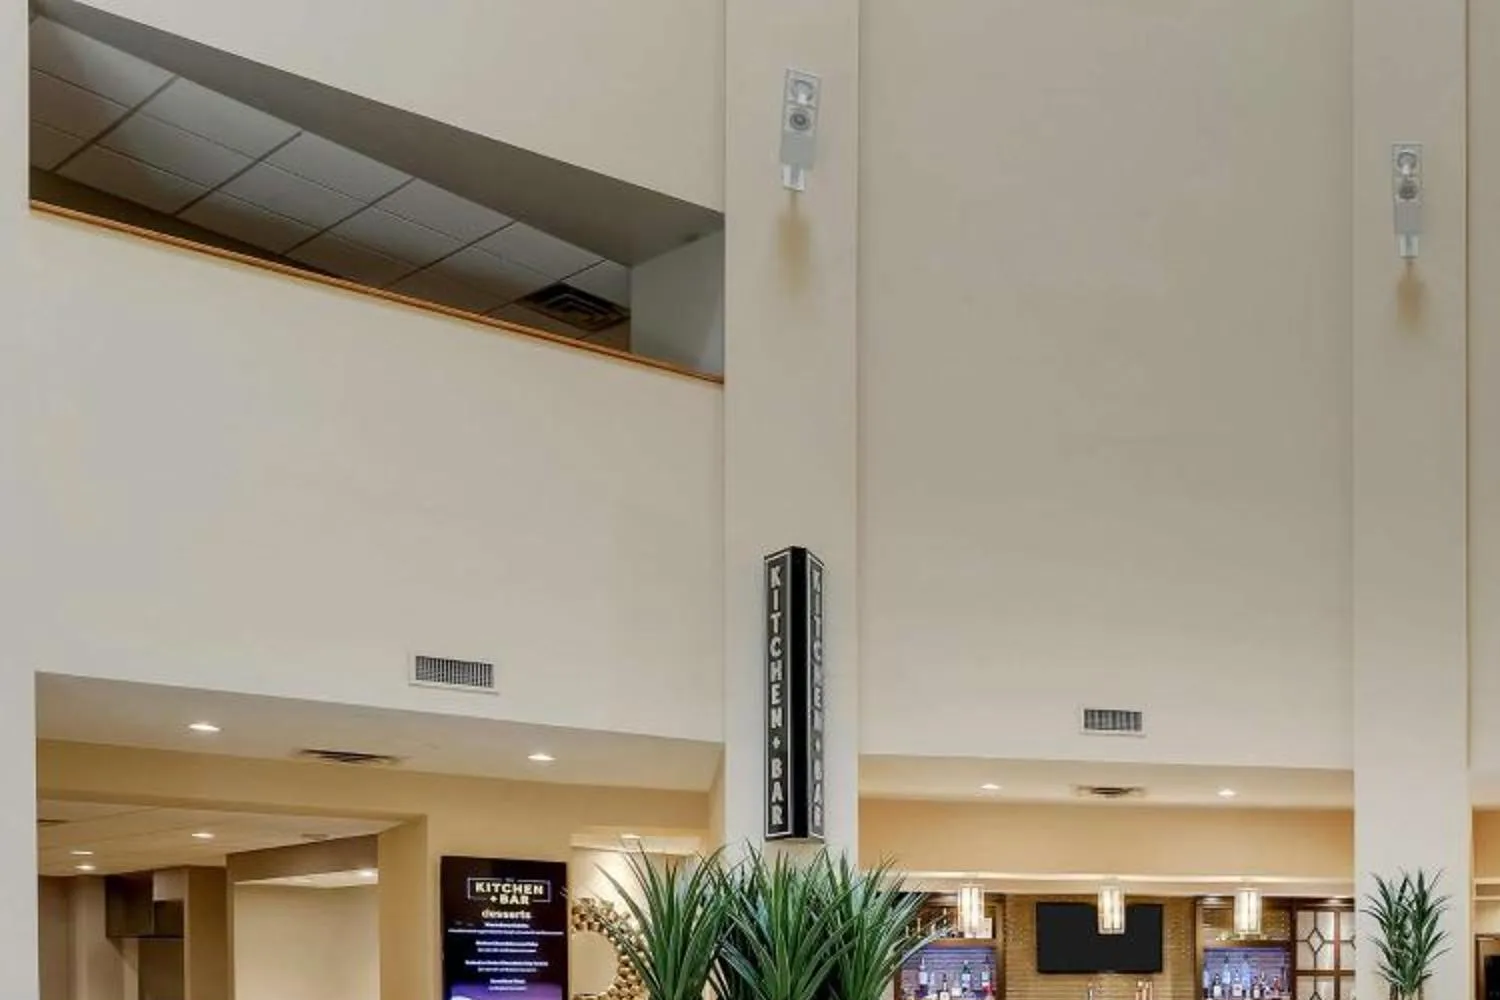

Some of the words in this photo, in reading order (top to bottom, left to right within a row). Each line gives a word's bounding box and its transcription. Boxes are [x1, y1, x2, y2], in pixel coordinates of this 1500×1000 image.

[770, 565, 783, 729] KITCHEN
[771, 757, 784, 825] BAR
[475, 881, 544, 895] KITCHEN
[481, 908, 532, 919] desserts
